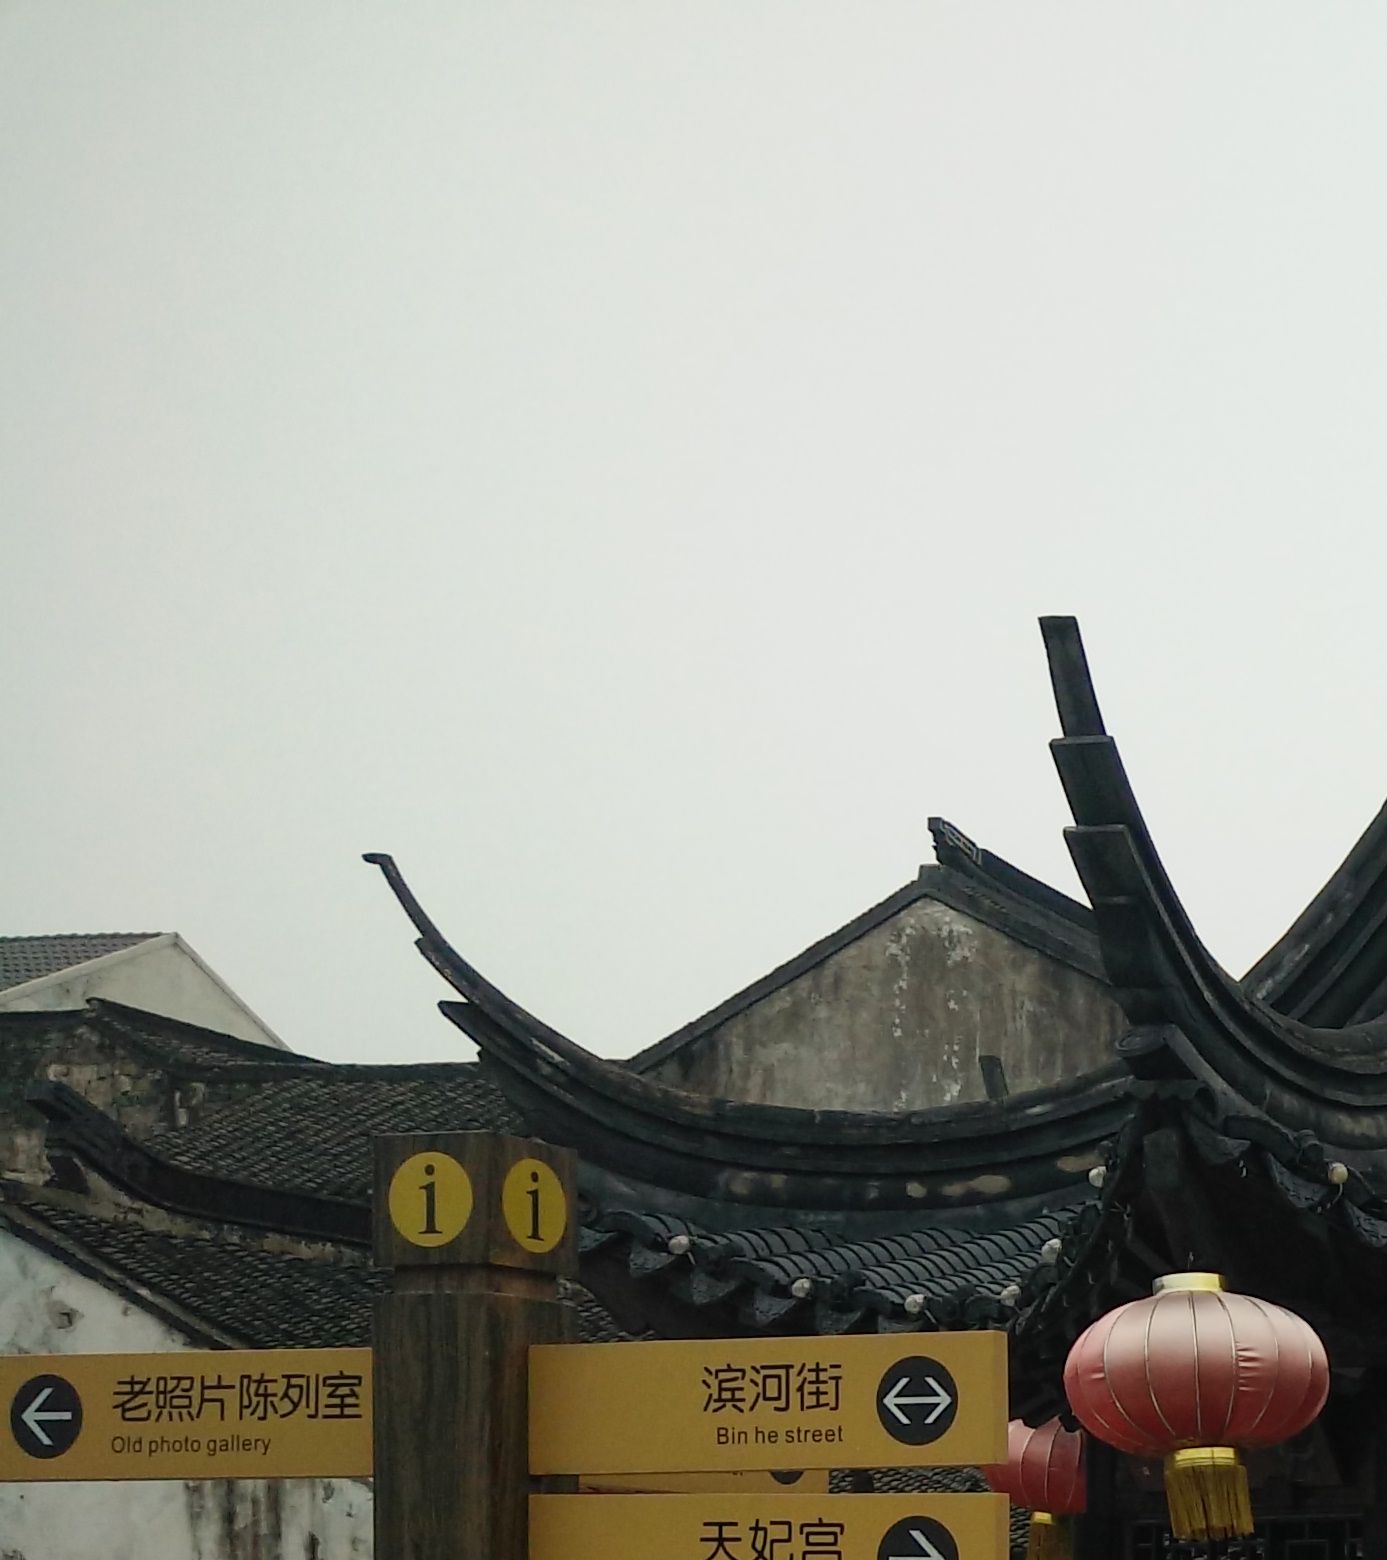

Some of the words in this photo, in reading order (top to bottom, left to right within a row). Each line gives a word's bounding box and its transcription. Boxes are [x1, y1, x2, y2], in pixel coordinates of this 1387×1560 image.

[112, 1370, 363, 1422] 老照片陈列室
[701, 1361, 842, 1412] 滨河街
[111, 1434, 143, 1453] Old
[148, 1435, 200, 1456] photo
[205, 1434, 271, 1456] gallery
[717, 1427, 747, 1444] Bin
[755, 1426, 778, 1443] he
[785, 1425, 843, 1443] street
